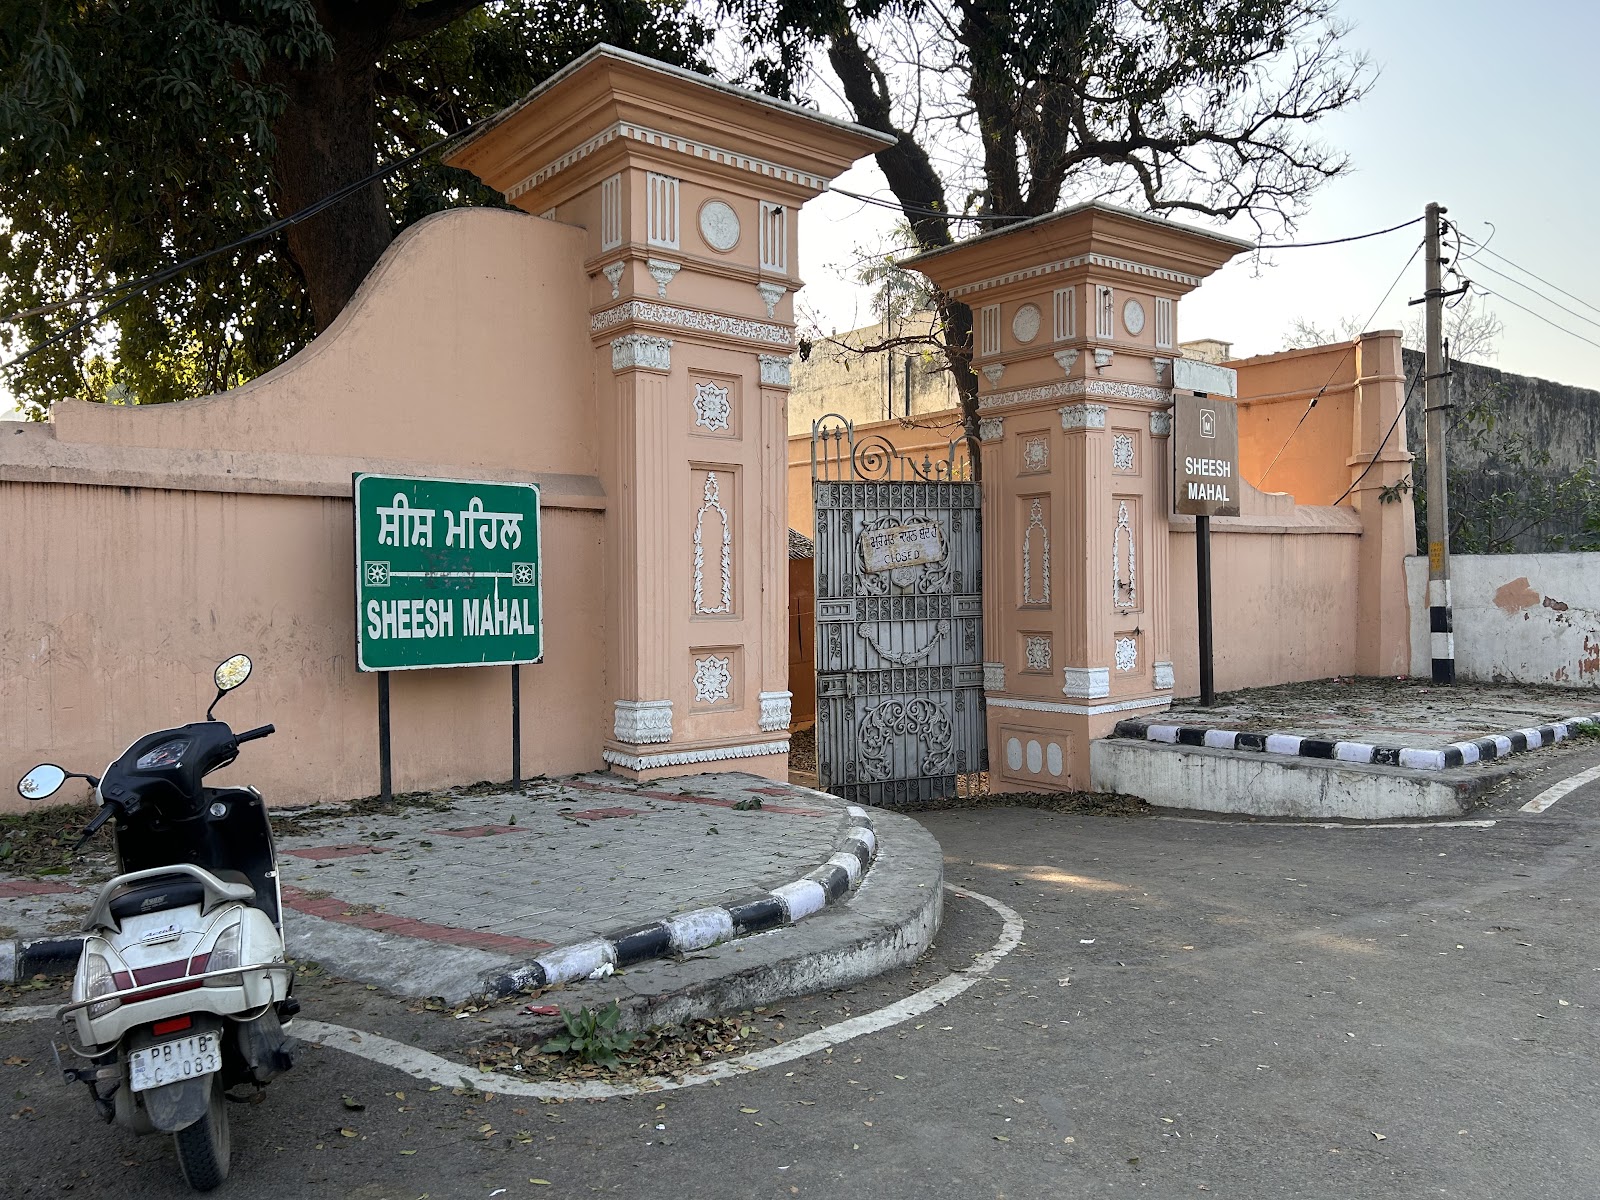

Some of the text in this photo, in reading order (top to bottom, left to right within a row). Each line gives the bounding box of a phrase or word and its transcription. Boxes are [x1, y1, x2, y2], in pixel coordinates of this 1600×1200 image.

[1185, 456, 1231, 478] SHEESH
[1188, 482, 1230, 502] MAHAL
[376, 492, 524, 550] ਸ਼ੀਸ਼ ਮਹਿਲ
[884, 549, 920, 564] CLOSED
[367, 598, 535, 640] SHEESH MAHAL
